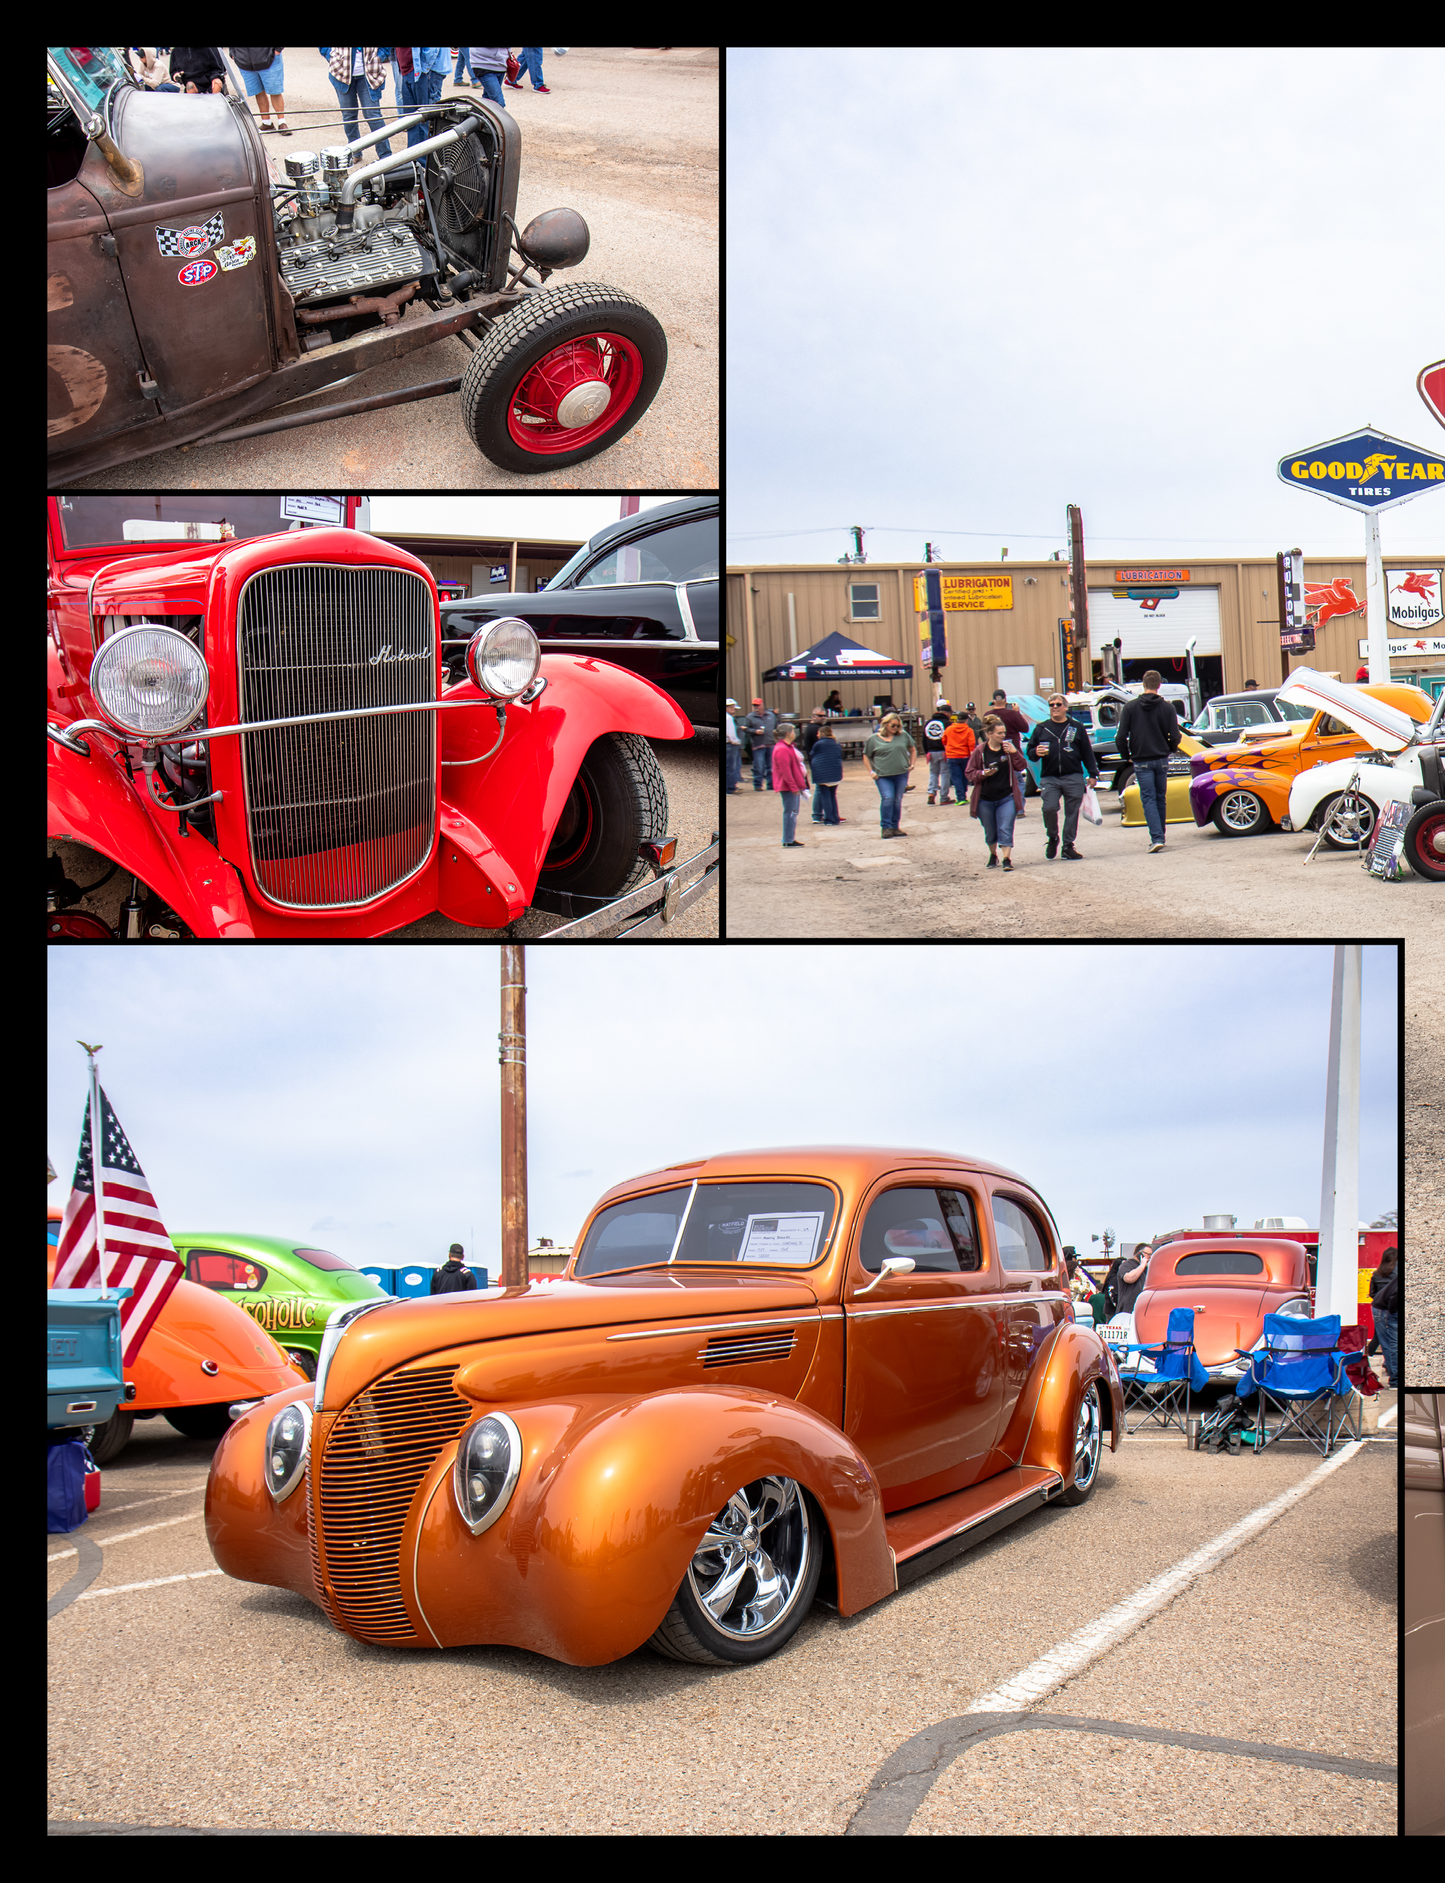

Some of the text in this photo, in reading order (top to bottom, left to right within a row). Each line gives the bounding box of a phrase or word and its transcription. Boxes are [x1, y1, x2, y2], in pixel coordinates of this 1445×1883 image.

[185, 239, 201, 248] ARCA
[184, 261, 212, 282] STP
[1291, 461, 1445, 480] GOOD YEAR
[1349, 487, 1391, 496] TIRES
[1121, 571, 1183, 580] LUBRICATION
[1391, 605, 1440, 621] Mobilgas
[1061, 619, 1076, 695] Firesto
[236, 1296, 318, 1331] SOHOLIC
[47, 1338, 78, 1357] ET
